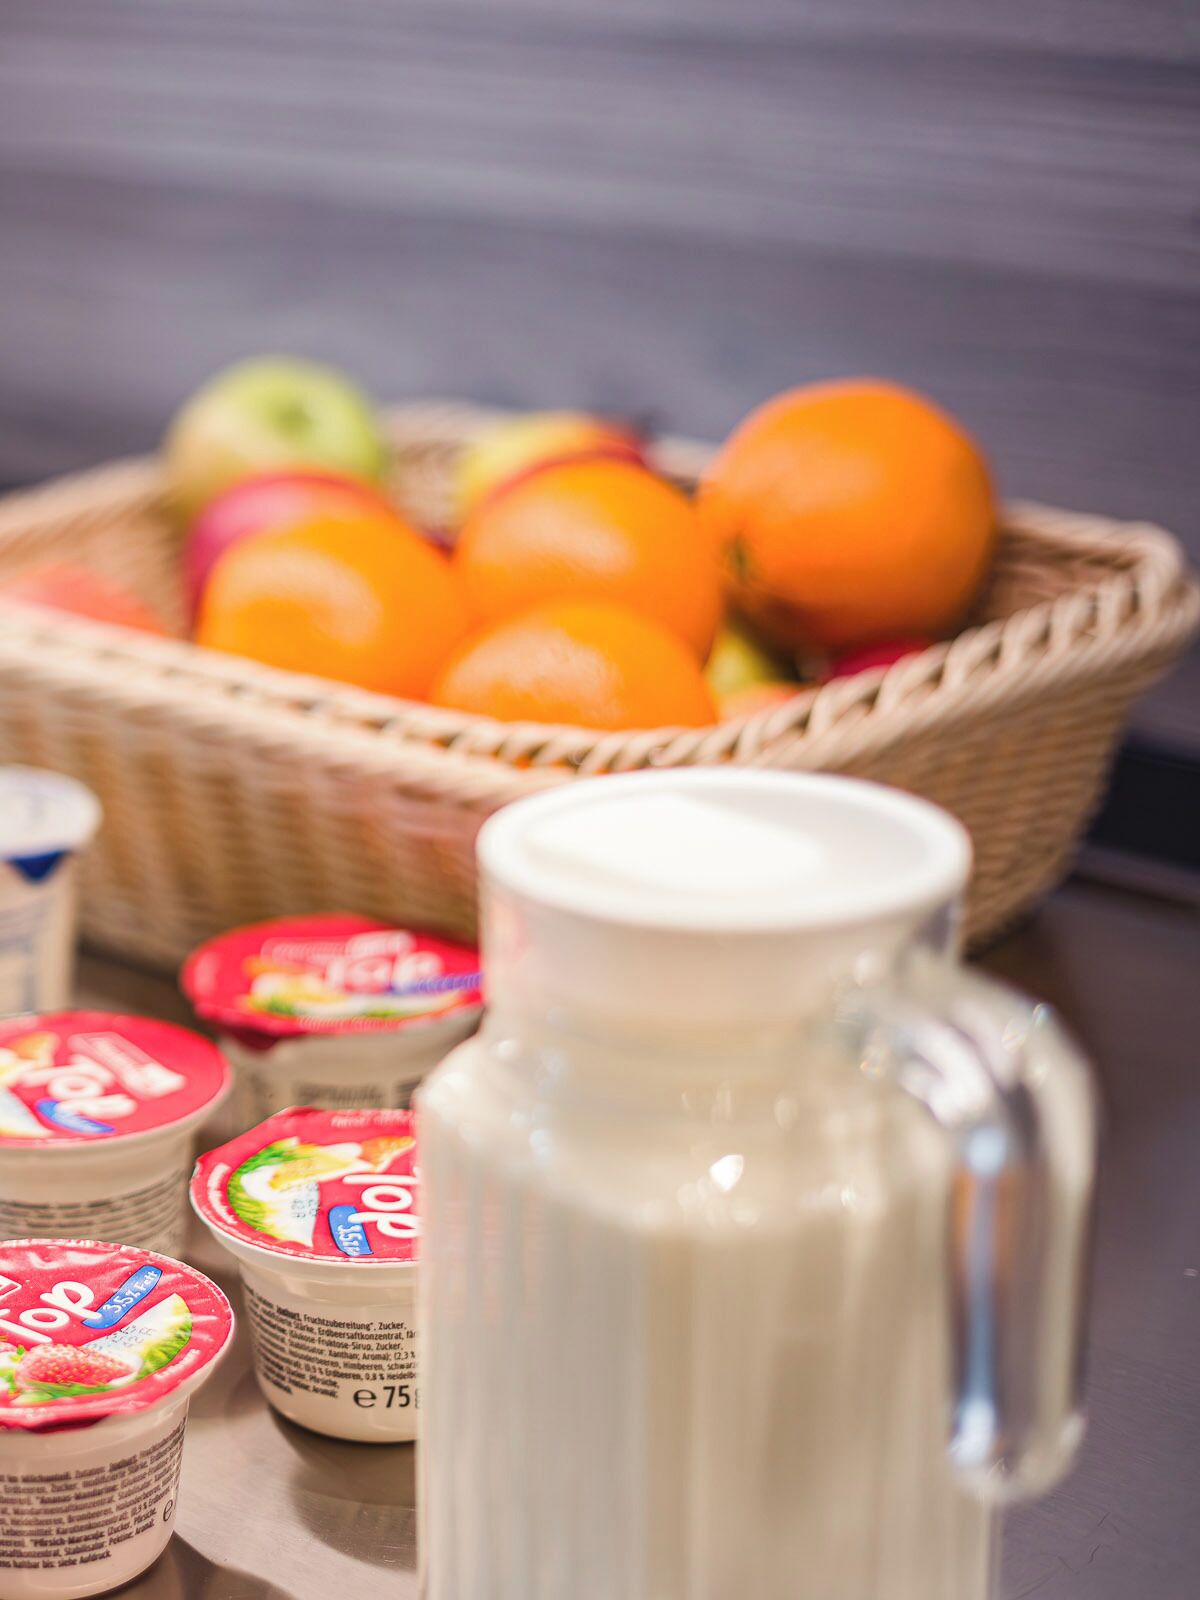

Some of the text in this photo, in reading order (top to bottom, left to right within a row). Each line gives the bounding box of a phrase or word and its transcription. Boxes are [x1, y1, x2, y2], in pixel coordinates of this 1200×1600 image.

[18, 1053, 138, 1120] Top
[135, 1270, 159, 1291] Fett
[378, 1321, 407, 1330] Zucker,
[318, 1327, 404, 1341] Erdbeersaftkonzentrat,
[375, 1342, 404, 1351] Zucker,
